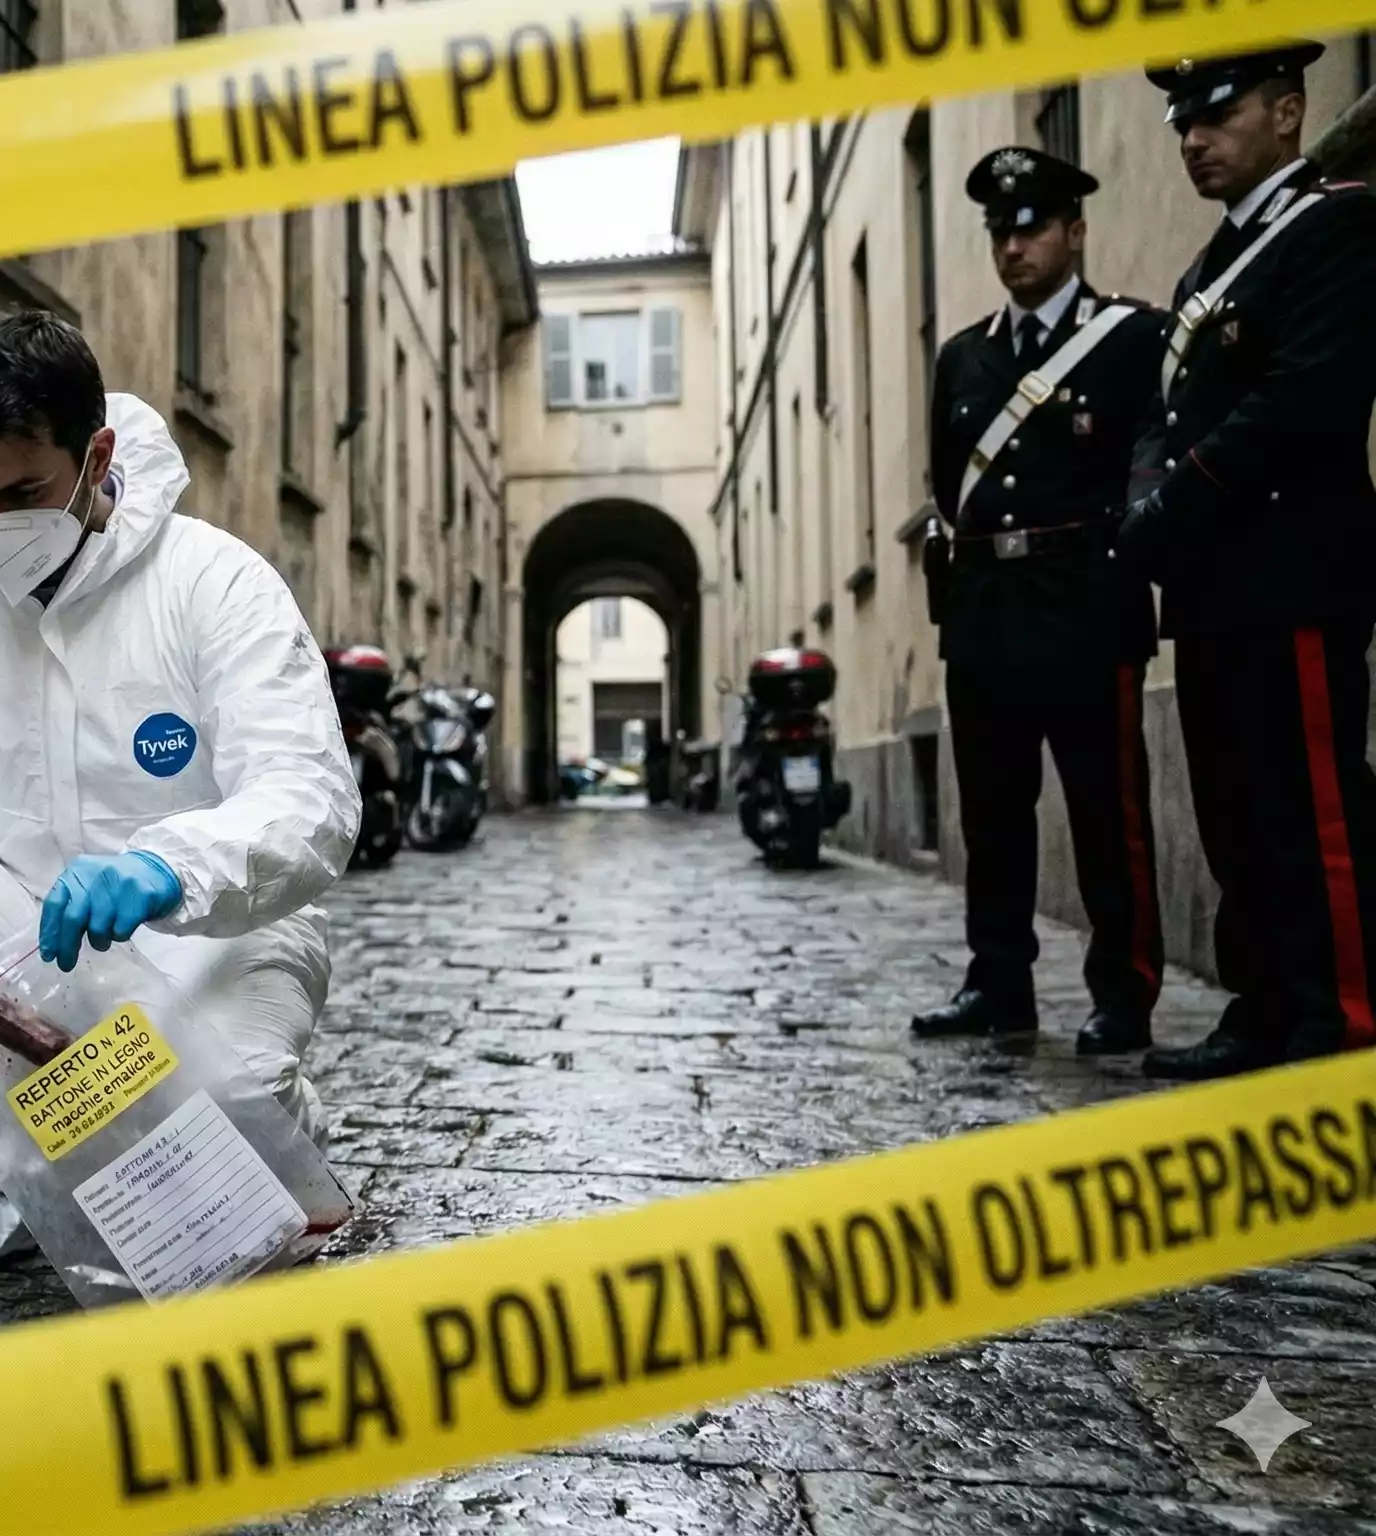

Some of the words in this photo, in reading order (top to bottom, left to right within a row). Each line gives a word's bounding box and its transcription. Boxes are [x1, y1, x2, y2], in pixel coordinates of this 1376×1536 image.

[171, 48, 422, 181] LINEA
[444, 0, 795, 136] POLIZIA
[137, 734, 188, 758] Tyvek
[15, 1043, 99, 1111] REPERTO
[114, 1014, 136, 1036] 42
[30, 1076, 94, 1128] BATTONE
[92, 1064, 109, 1083] IN
[108, 1031, 150, 1070] LEGNO
[51, 1091, 104, 1134] macchie
[105, 1324, 404, 1501] LINEA
[423, 1243, 769, 1429] POLIZIA
[780, 1197, 957, 1339] NON
